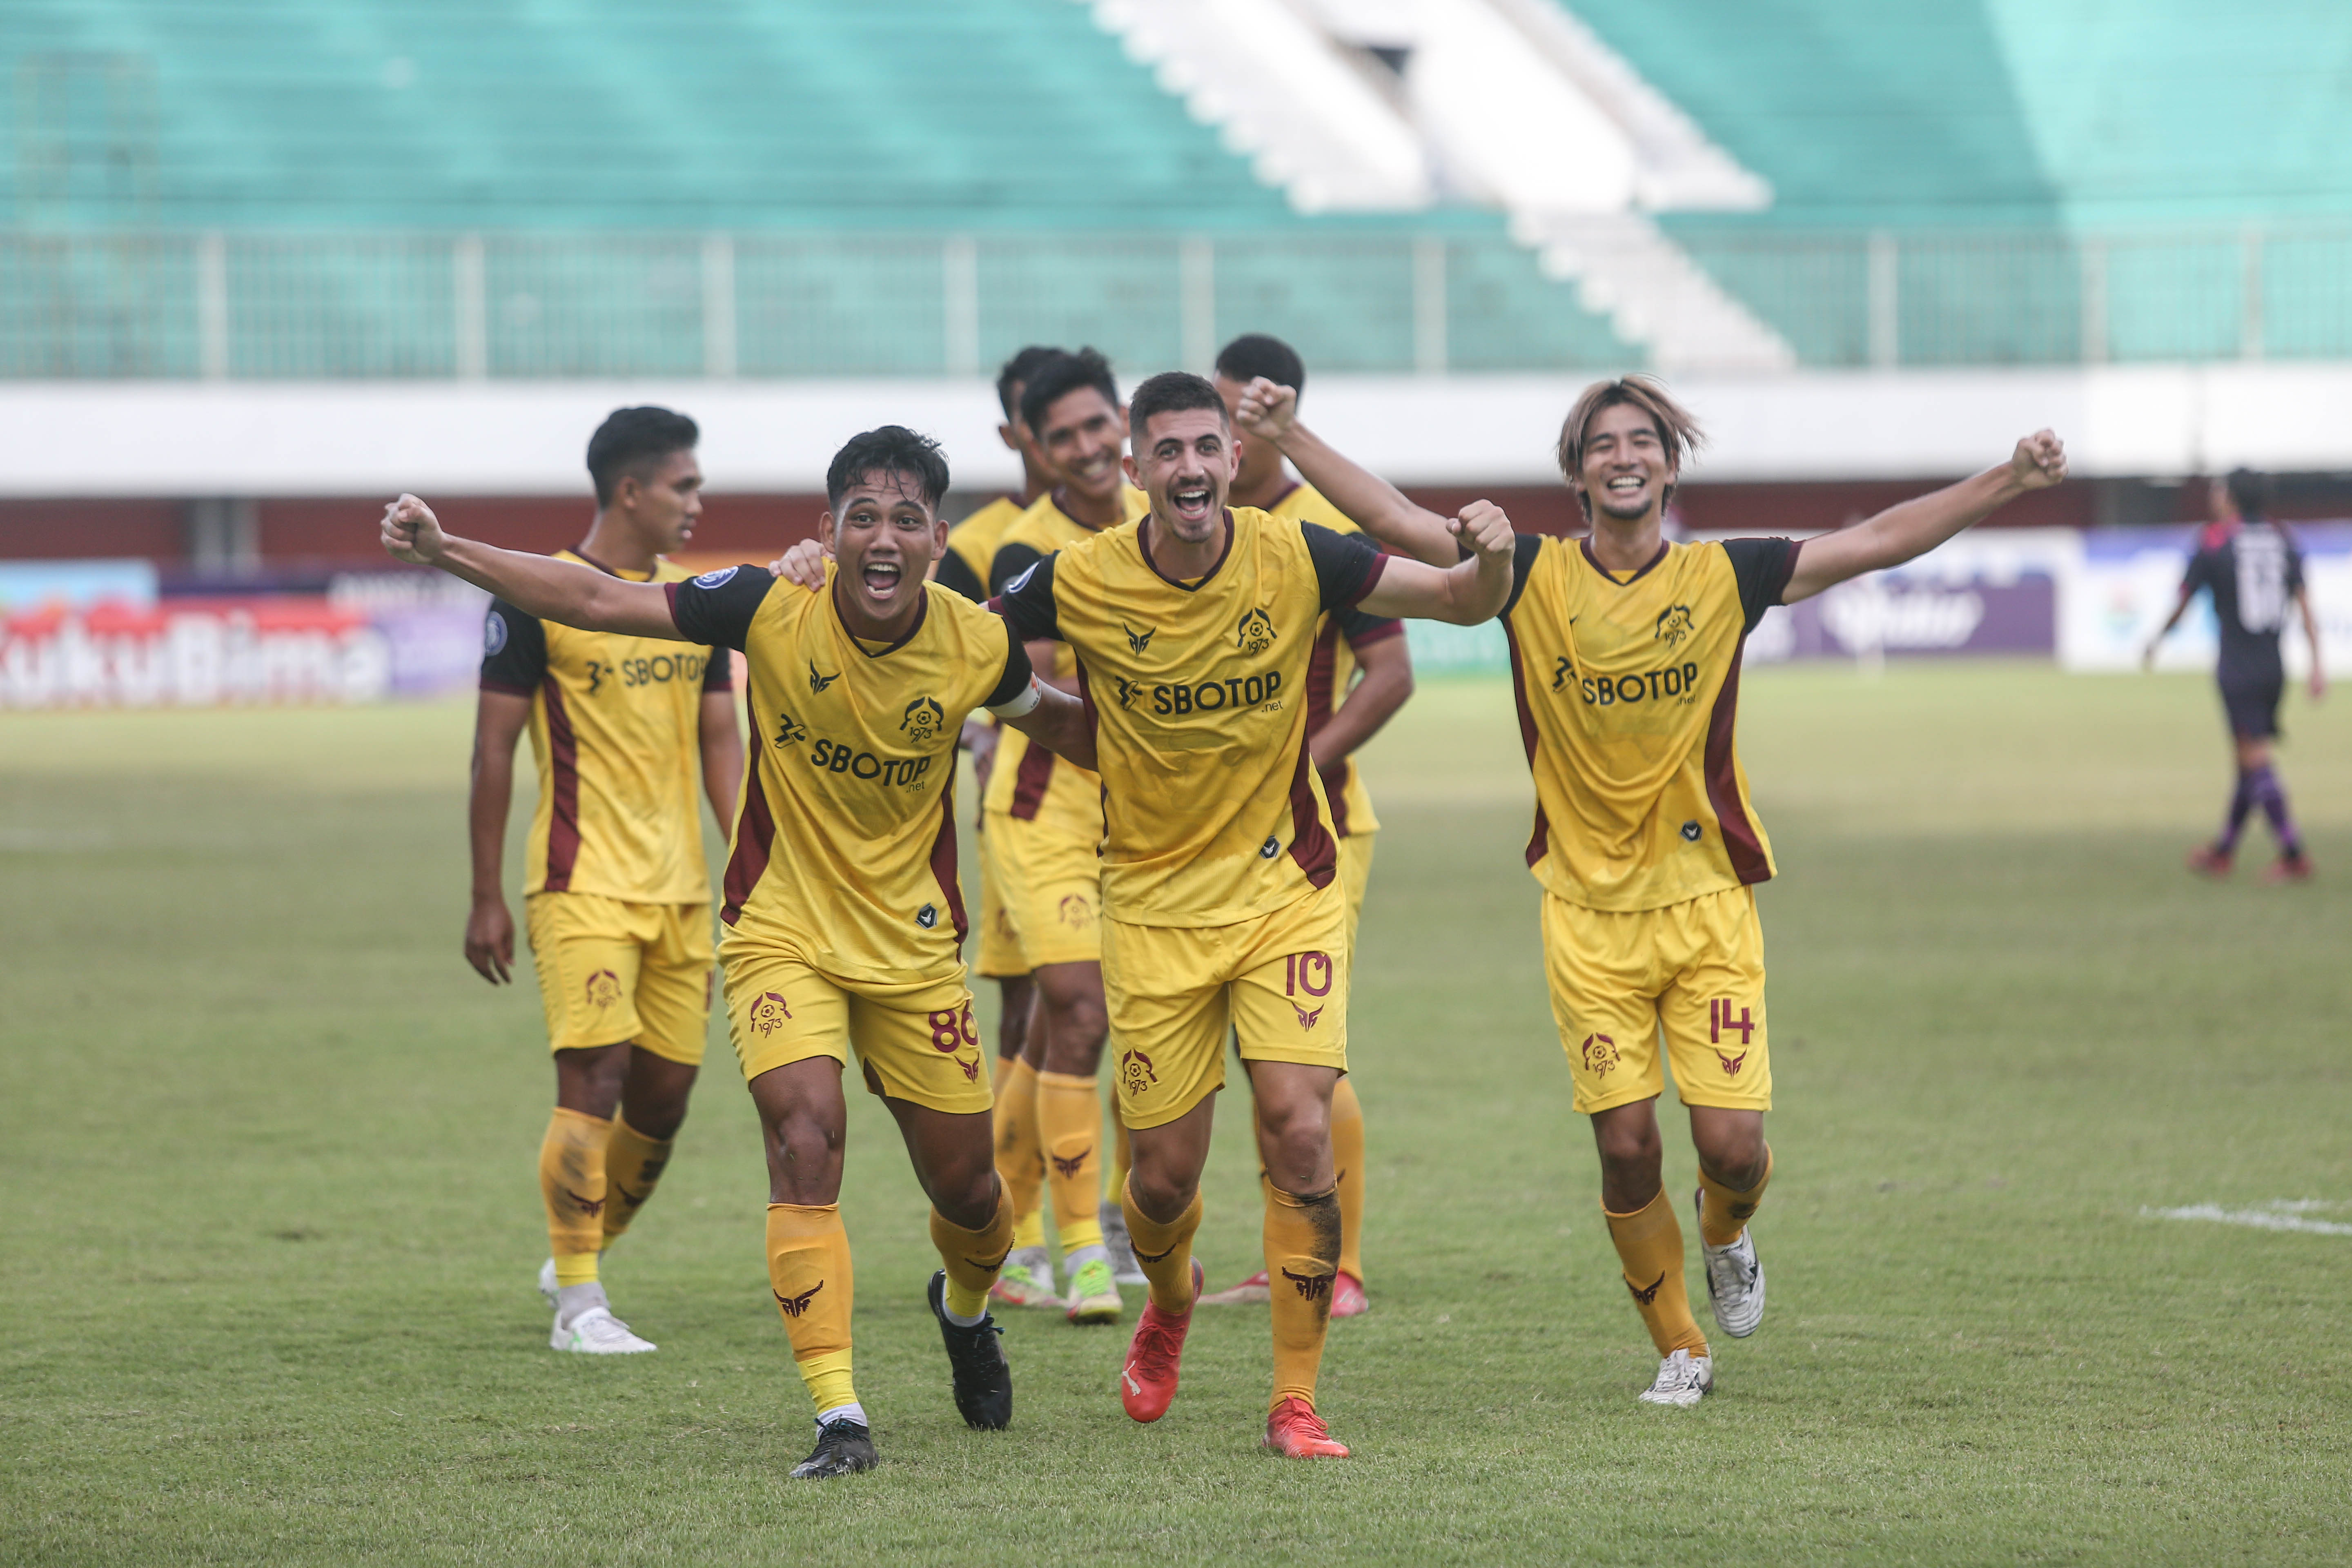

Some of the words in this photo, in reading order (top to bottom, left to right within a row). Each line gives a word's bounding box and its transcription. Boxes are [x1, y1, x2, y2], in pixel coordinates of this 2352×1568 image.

[1247, 638, 1270, 656] 1973
[1154, 670, 1281, 715] SBOTOP
[1582, 662, 1698, 706] SBOTOP
[1261, 699, 1284, 713] .net
[910, 726, 932, 744] 1973
[811, 738, 931, 787] SBOTOP
[906, 780, 925, 793] .net
[1286, 951, 1332, 997] 10
[758, 1018, 783, 1038] 1973
[929, 998, 979, 1053] 86
[1711, 998, 1755, 1045] 14
[1592, 1059, 1615, 1080] 1973
[1128, 1079, 1148, 1097] 1973
